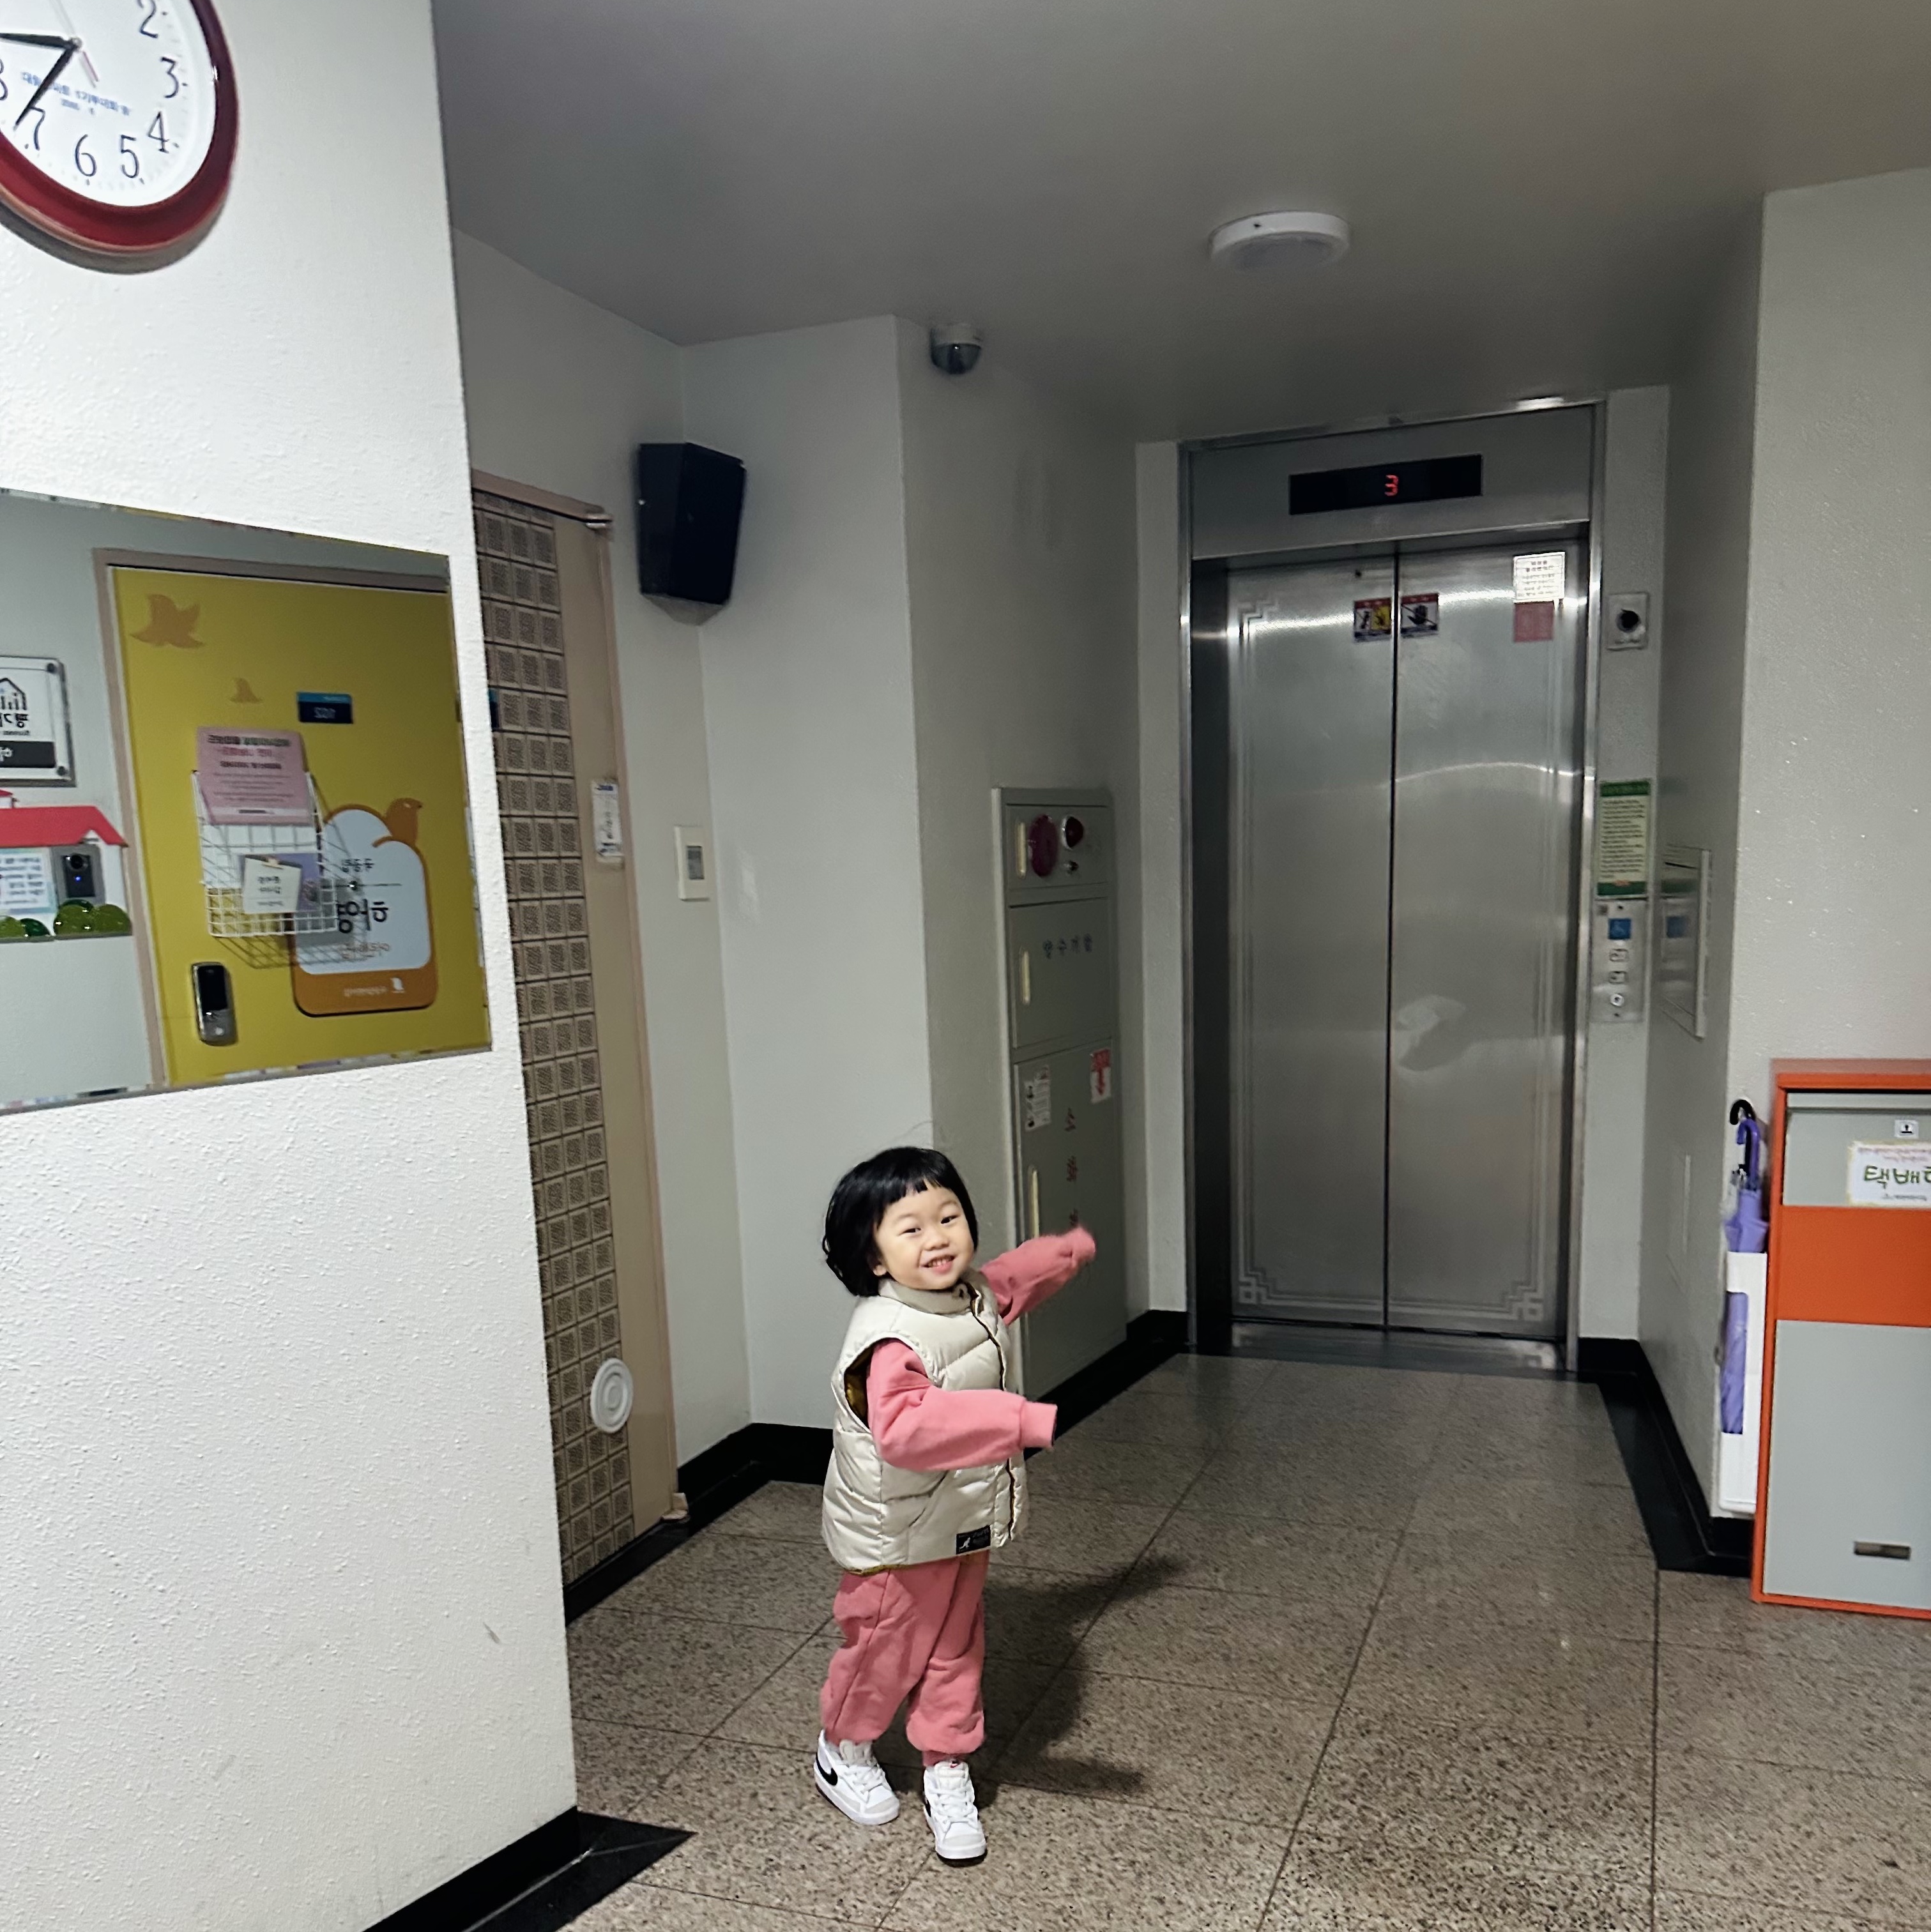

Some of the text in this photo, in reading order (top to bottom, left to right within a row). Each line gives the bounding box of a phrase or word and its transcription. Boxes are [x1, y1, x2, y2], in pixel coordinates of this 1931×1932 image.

[138, 0, 158, 38] 2
[160, 56, 180, 98] 3
[30, 105, 46, 150] 7
[148, 110, 169, 154] 4
[74, 133, 97, 177] 6
[119, 134, 140, 178] 5
[1384, 474, 1399, 496] 3
